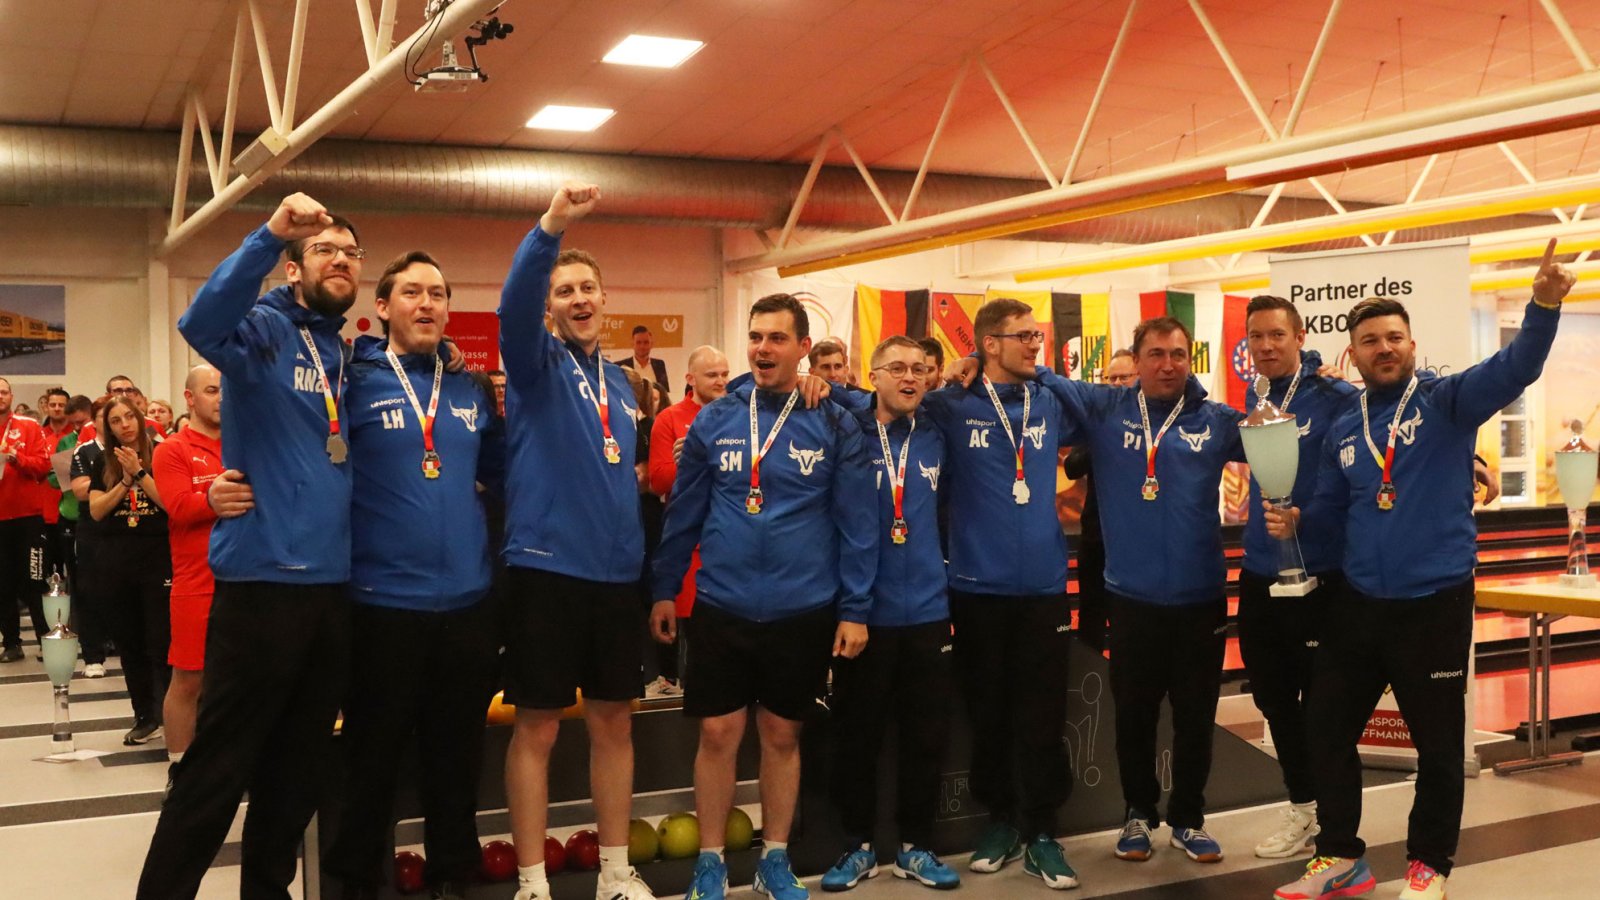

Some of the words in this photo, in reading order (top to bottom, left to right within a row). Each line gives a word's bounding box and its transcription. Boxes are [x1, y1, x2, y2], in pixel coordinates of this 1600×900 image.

[1291, 283, 1367, 302] Partner
[1374, 277, 1412, 297] des
[381, 408, 405, 430] LH
[966, 419, 996, 427] uhlsport
[716, 438, 746, 446] uhlsport
[969, 429, 989, 448] AC
[1123, 431, 1142, 450] PJ
[720, 450, 743, 471] SM
[1430, 669, 1463, 679] uhlsport
[1367, 717, 1408, 728] MSPOR
